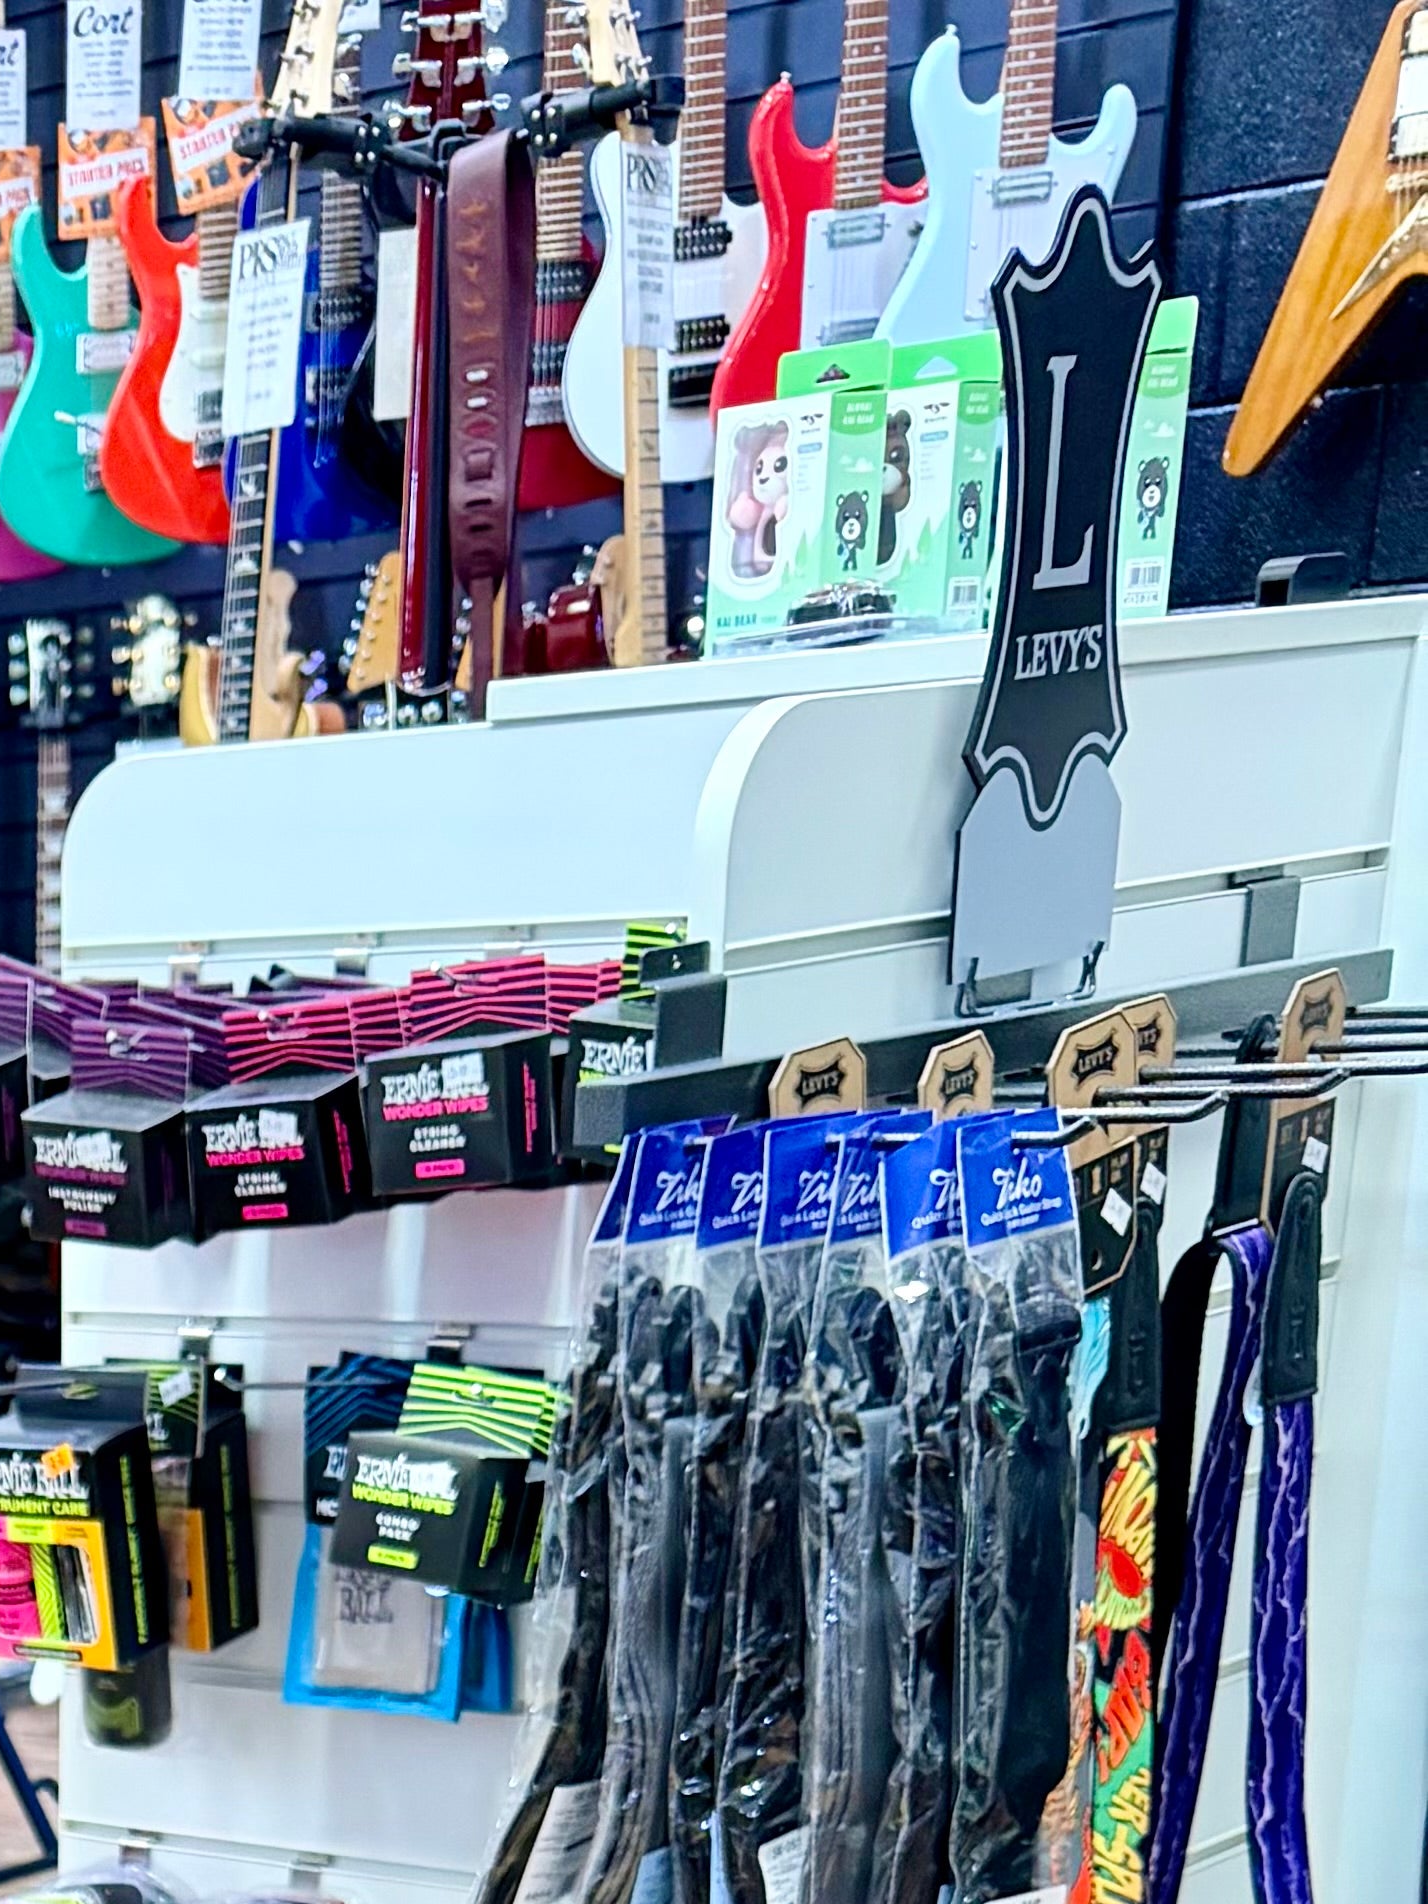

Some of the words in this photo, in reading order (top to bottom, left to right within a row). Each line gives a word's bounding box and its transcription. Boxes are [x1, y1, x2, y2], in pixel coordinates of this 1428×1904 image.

[73, 5, 135, 37] Cort
[1033, 354, 1094, 590] L
[1014, 624, 1102, 680] LEVY'S
[581, 1033, 645, 1076] ERNIE
[381, 1063, 442, 1106] ERNIE
[382, 1101, 443, 1121] WONDER
[444, 1097, 489, 1115] WIPES
[202, 1114, 258, 1152] ERNIE
[52, 1499, 91, 1517] CARE
